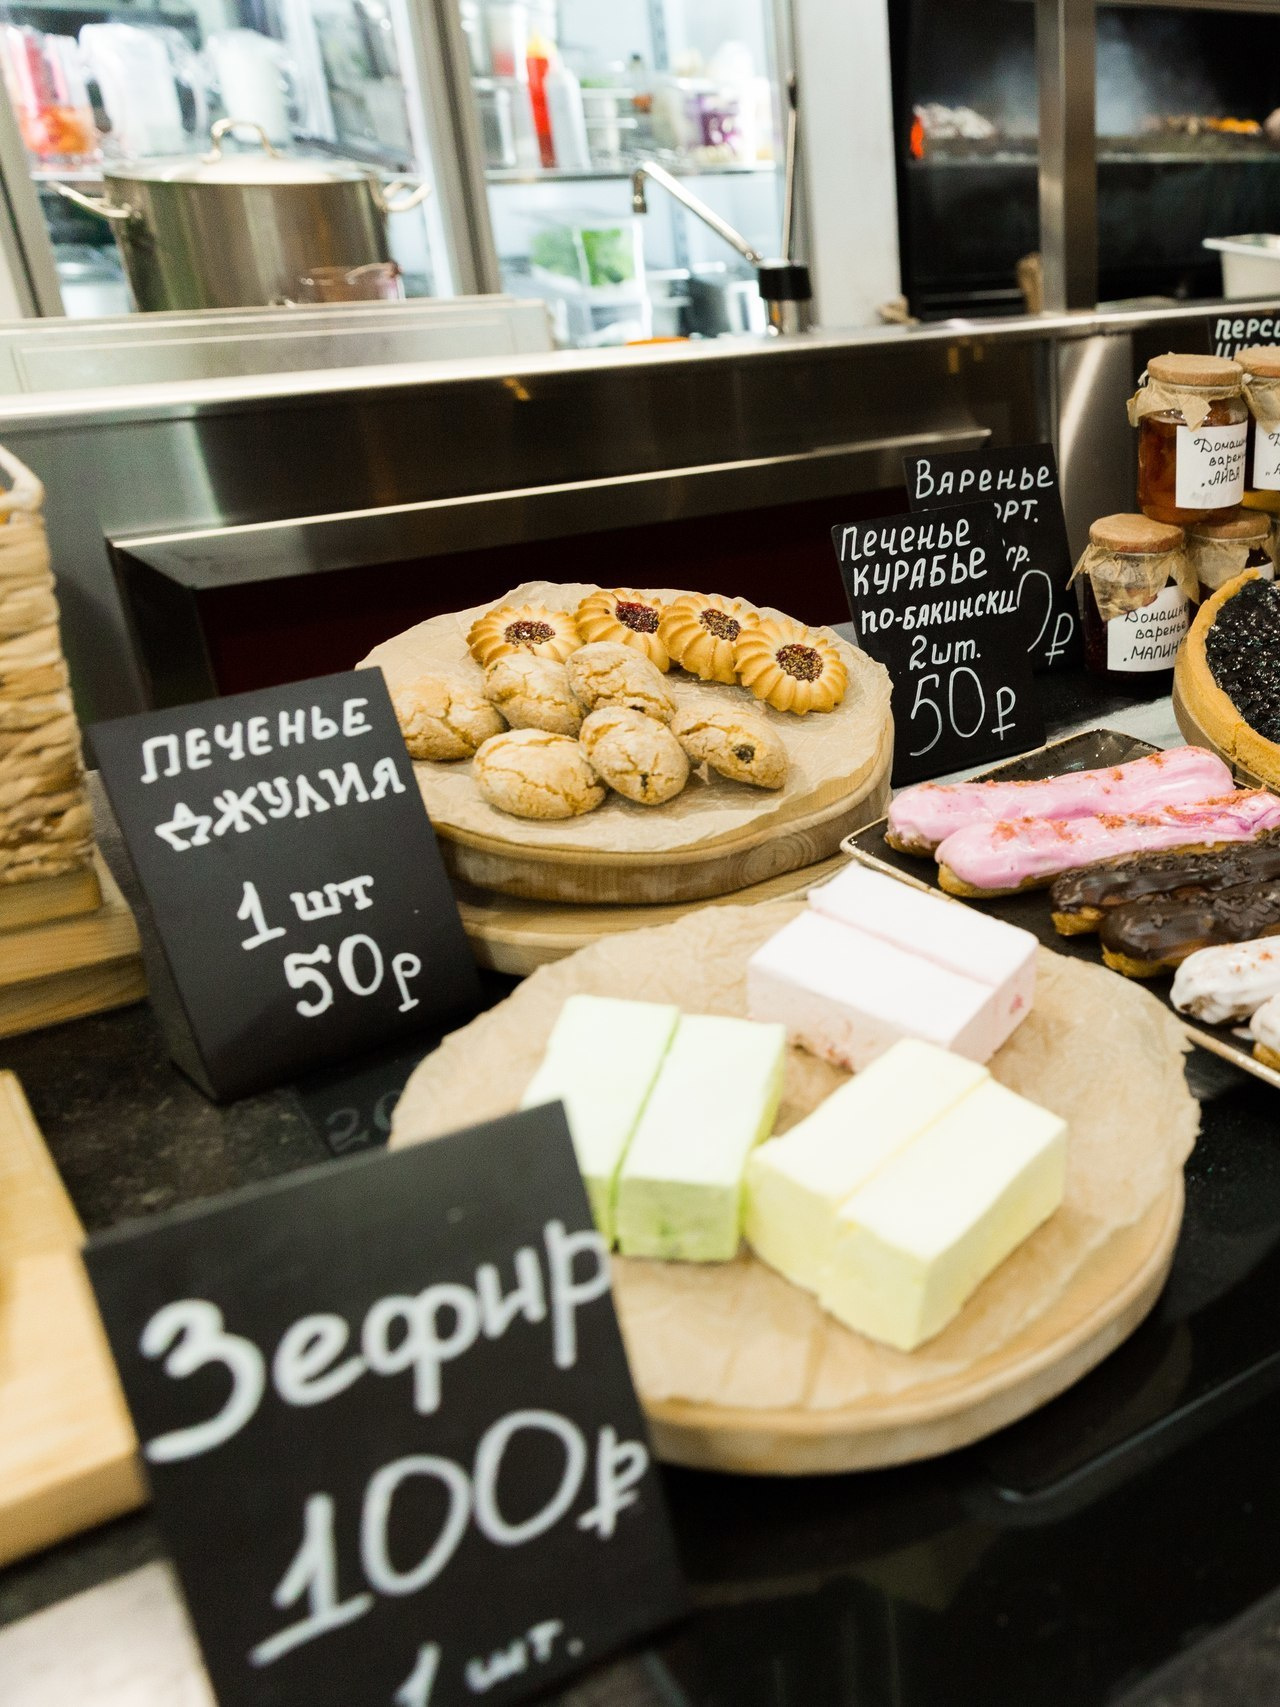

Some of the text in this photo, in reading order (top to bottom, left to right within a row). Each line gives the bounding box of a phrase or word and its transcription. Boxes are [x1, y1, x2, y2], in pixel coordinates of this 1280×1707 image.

[140, 697, 373, 784] ПЕЧЕНЬЕ
[154, 756, 406, 851] ДЖУЛИЯ
[236, 880, 287, 950] 1
[140, 1218, 618, 1465] Зефир
